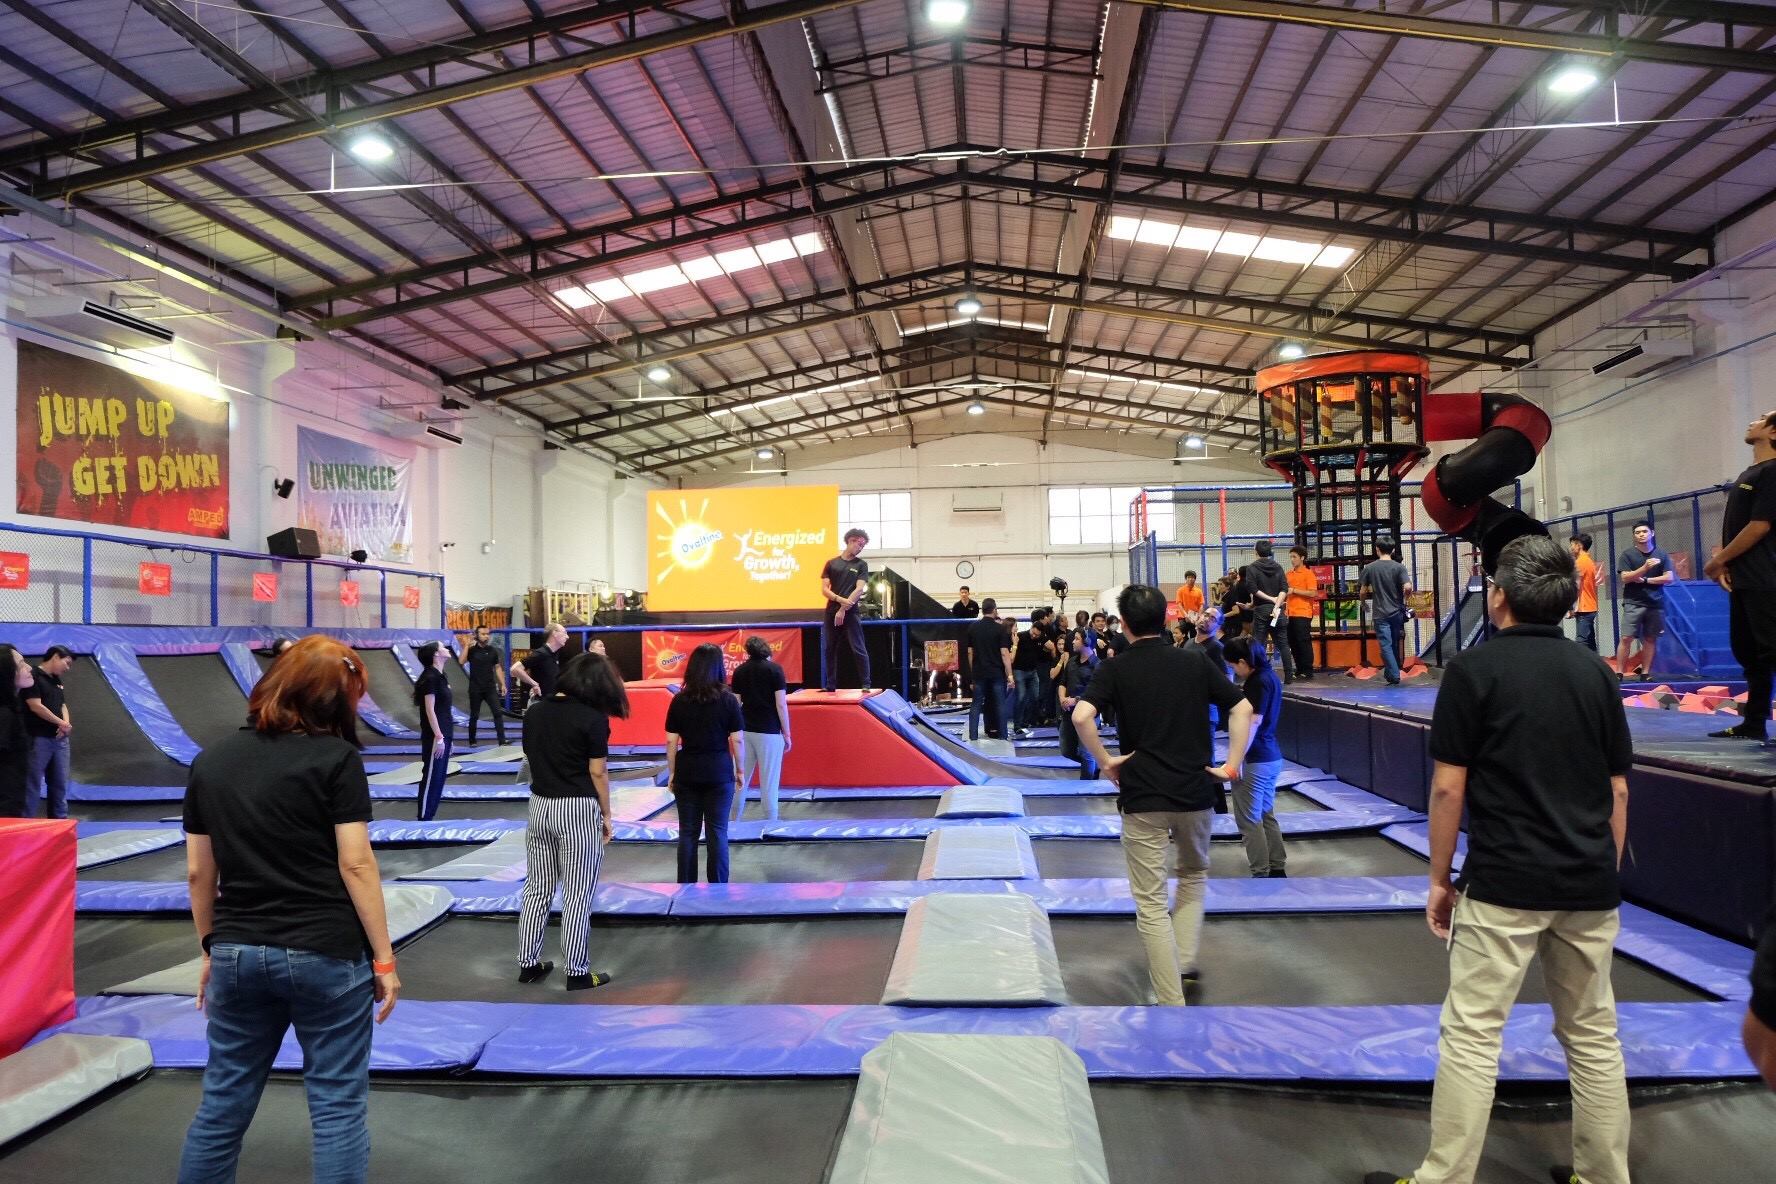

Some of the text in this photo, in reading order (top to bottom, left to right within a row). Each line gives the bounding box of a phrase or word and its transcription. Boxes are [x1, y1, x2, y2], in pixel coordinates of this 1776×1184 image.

[38, 391, 175, 448] JUMP UP
[72, 453, 220, 496] GET DOWN
[309, 461, 397, 491] UNWINGED
[753, 528, 826, 550] Energized
